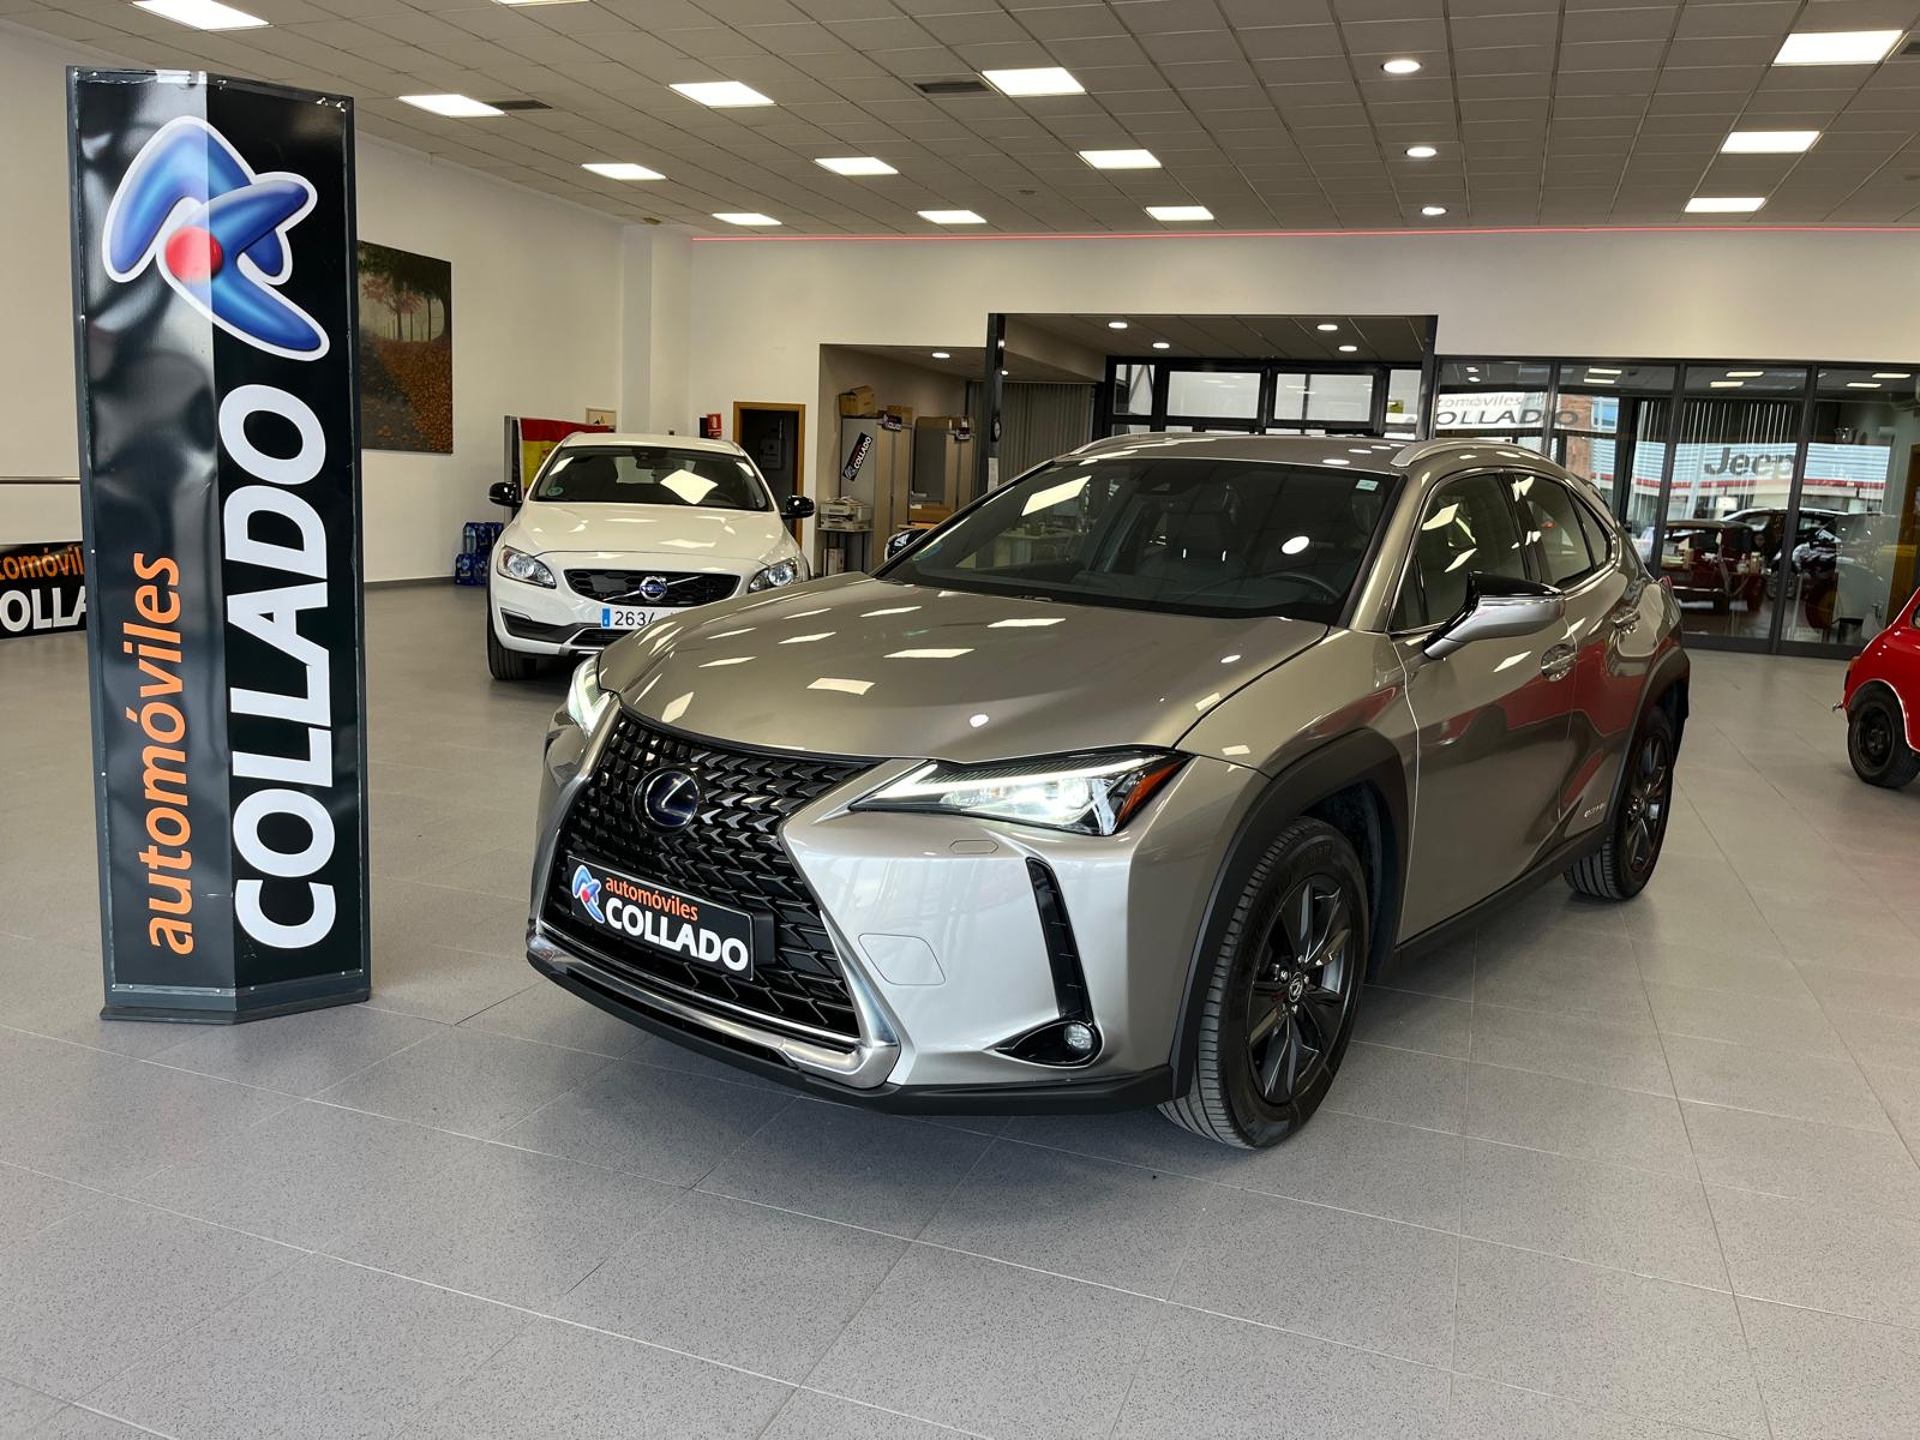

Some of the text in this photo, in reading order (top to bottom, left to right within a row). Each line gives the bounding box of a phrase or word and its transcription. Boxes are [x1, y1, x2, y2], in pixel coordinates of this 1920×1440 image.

[1438, 394, 1521, 408] omóviles
[853, 436, 872, 469] COLLADO
[218, 384, 337, 949] COLLADO
[123, 553, 193, 956] automóviles
[605, 877, 698, 921] automóviles
[606, 898, 748, 971] COLLADO
